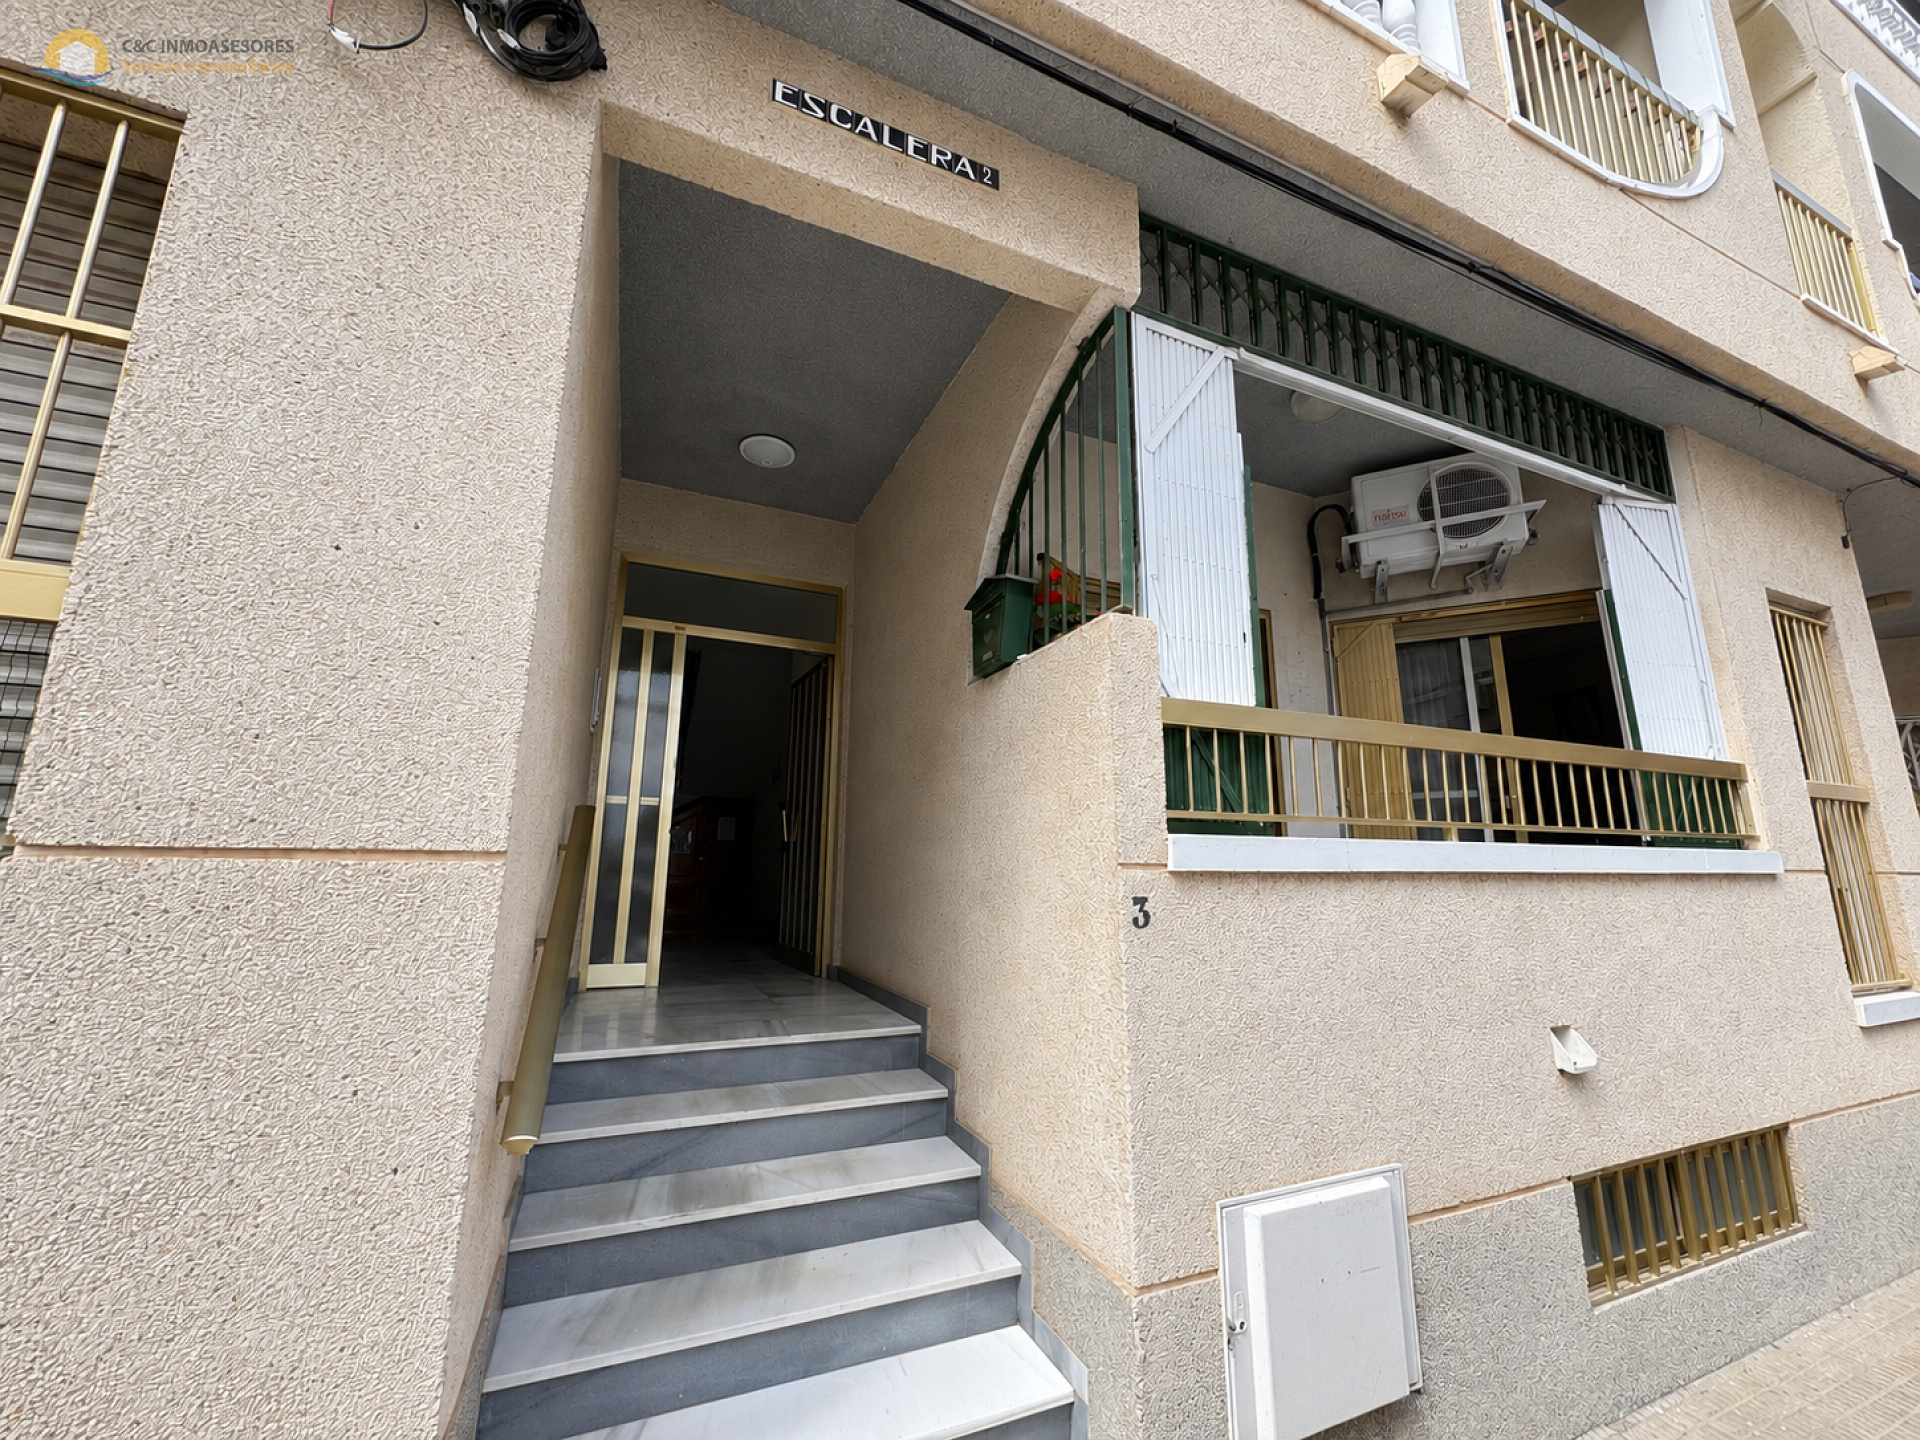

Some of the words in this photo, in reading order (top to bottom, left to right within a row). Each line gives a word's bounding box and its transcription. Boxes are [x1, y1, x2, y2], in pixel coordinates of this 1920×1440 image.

[773, 80, 976, 181] ESCALERA
[983, 166, 993, 185] 2
[1131, 895, 1151, 929] 3
